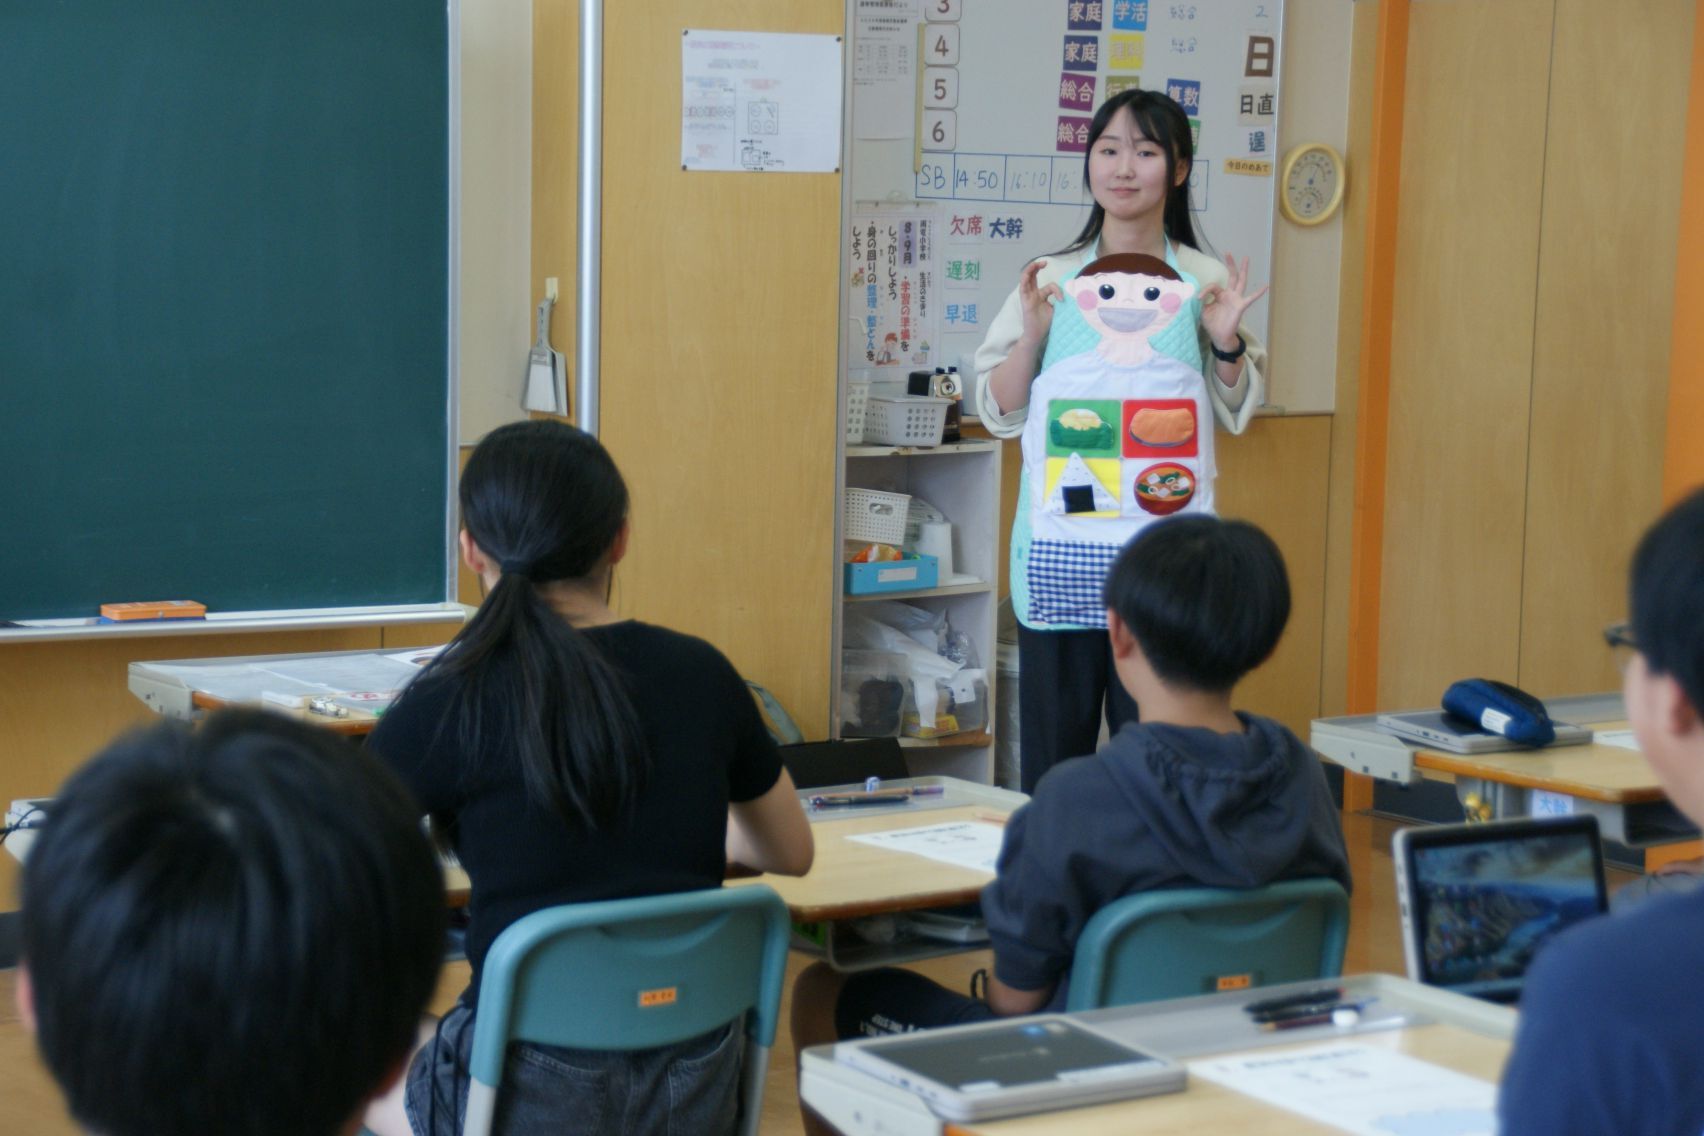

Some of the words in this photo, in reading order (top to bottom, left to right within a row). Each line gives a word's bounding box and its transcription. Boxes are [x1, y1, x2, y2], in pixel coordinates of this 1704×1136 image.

[937, 0, 950, 14] 3
[1070, 1, 1102, 22] 家庭
[1115, 0, 1146, 22] 学活
[1255, 6, 1269, 18] 2
[934, 35, 950, 57] 4
[1064, 41, 1098, 63] 家庭
[1244, 36, 1275, 77] 日
[934, 78, 947, 100] 5
[1060, 80, 1094, 102] 総合
[1167, 85, 1199, 107] 算数
[1240, 94, 1275, 116] 日直
[931, 119, 945, 142] 6
[1057, 122, 1089, 143] 総合
[920, 164, 946, 190] SB
[955, 169, 998, 189] 14:50
[951, 215, 983, 236] 欠席
[852, 226, 862, 260] しよう
[888, 226, 897, 300] しっかりしよう
[945, 260, 981, 281] 遅刻
[944, 304, 978, 324] 早退
